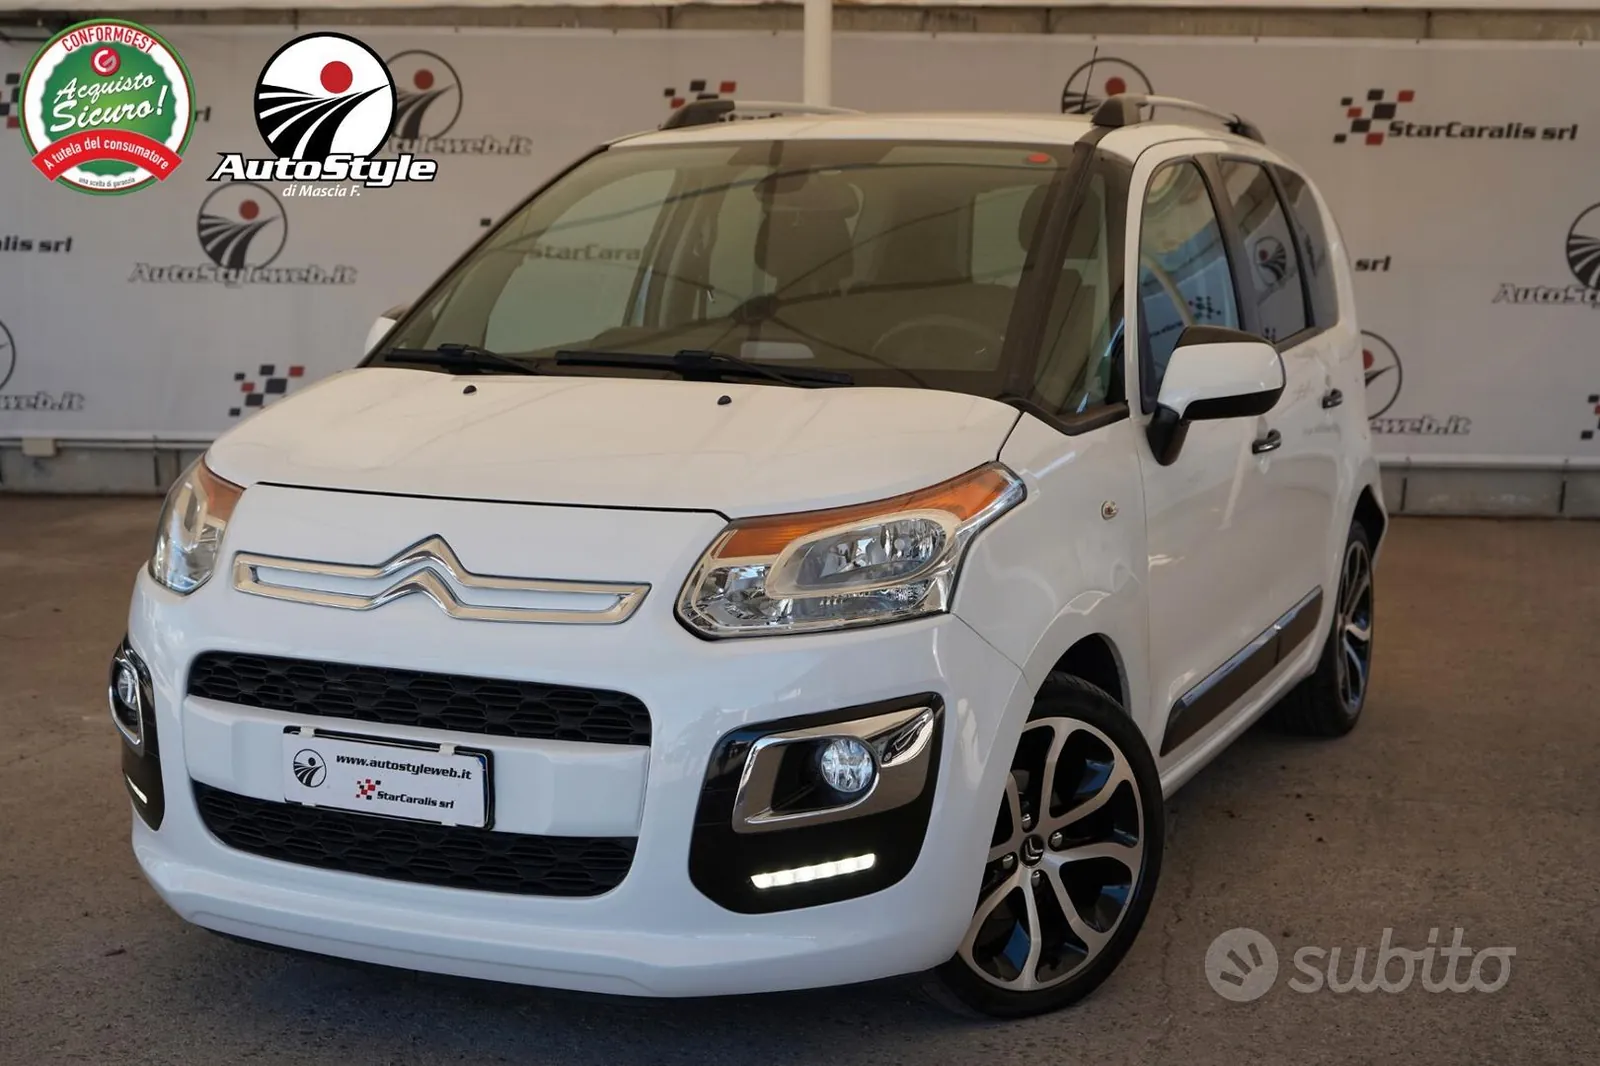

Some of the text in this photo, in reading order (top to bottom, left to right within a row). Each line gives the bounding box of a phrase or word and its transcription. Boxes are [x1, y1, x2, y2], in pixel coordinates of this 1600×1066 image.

[194, 106, 211, 123] rl
[1388, 120, 1578, 142] StarCaralis srl
[388, 135, 533, 156] tyleweb.it
[0, 235, 73, 253] lis srl
[527, 243, 641, 261] StarCara
[1355, 255, 1392, 272] srl
[128, 262, 357, 290] AutoStyleweb.it
[0, 391, 85, 411] web.it
[1369, 414, 1472, 435] eweb.it
[336, 753, 472, 780] www.autostyleweb.it
[377, 790, 455, 809] StarCaralis srl
